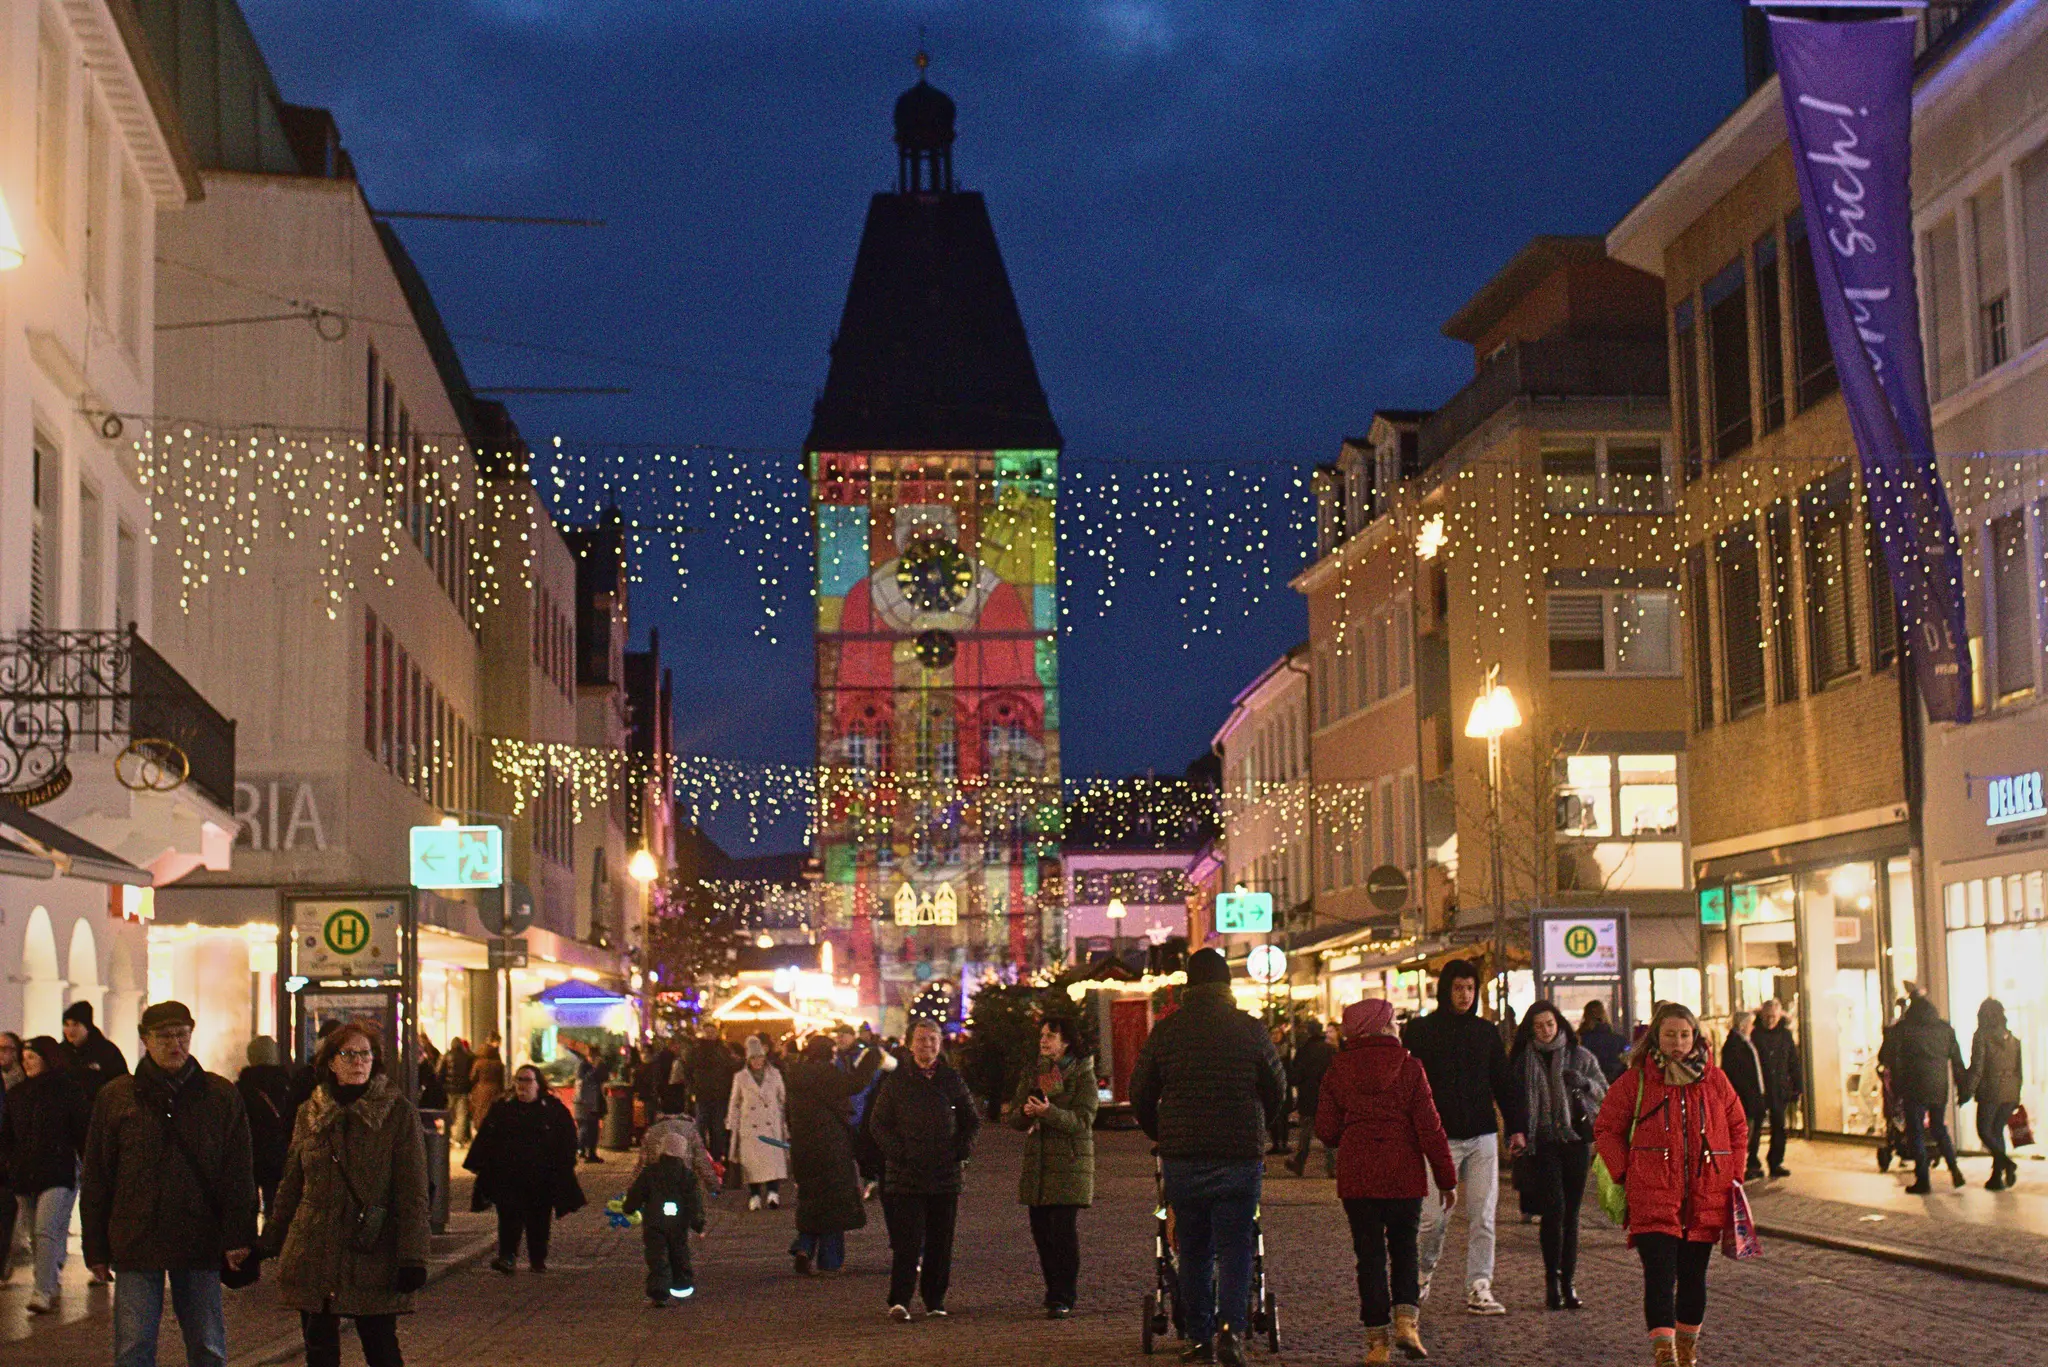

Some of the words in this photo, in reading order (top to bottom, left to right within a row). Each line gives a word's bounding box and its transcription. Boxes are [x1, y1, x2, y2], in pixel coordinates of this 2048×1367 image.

[1799, 93, 1876, 257] sich!
[1989, 771, 2043, 818] DELKER
[337, 919, 357, 946] H
[1574, 931, 1588, 952] H
